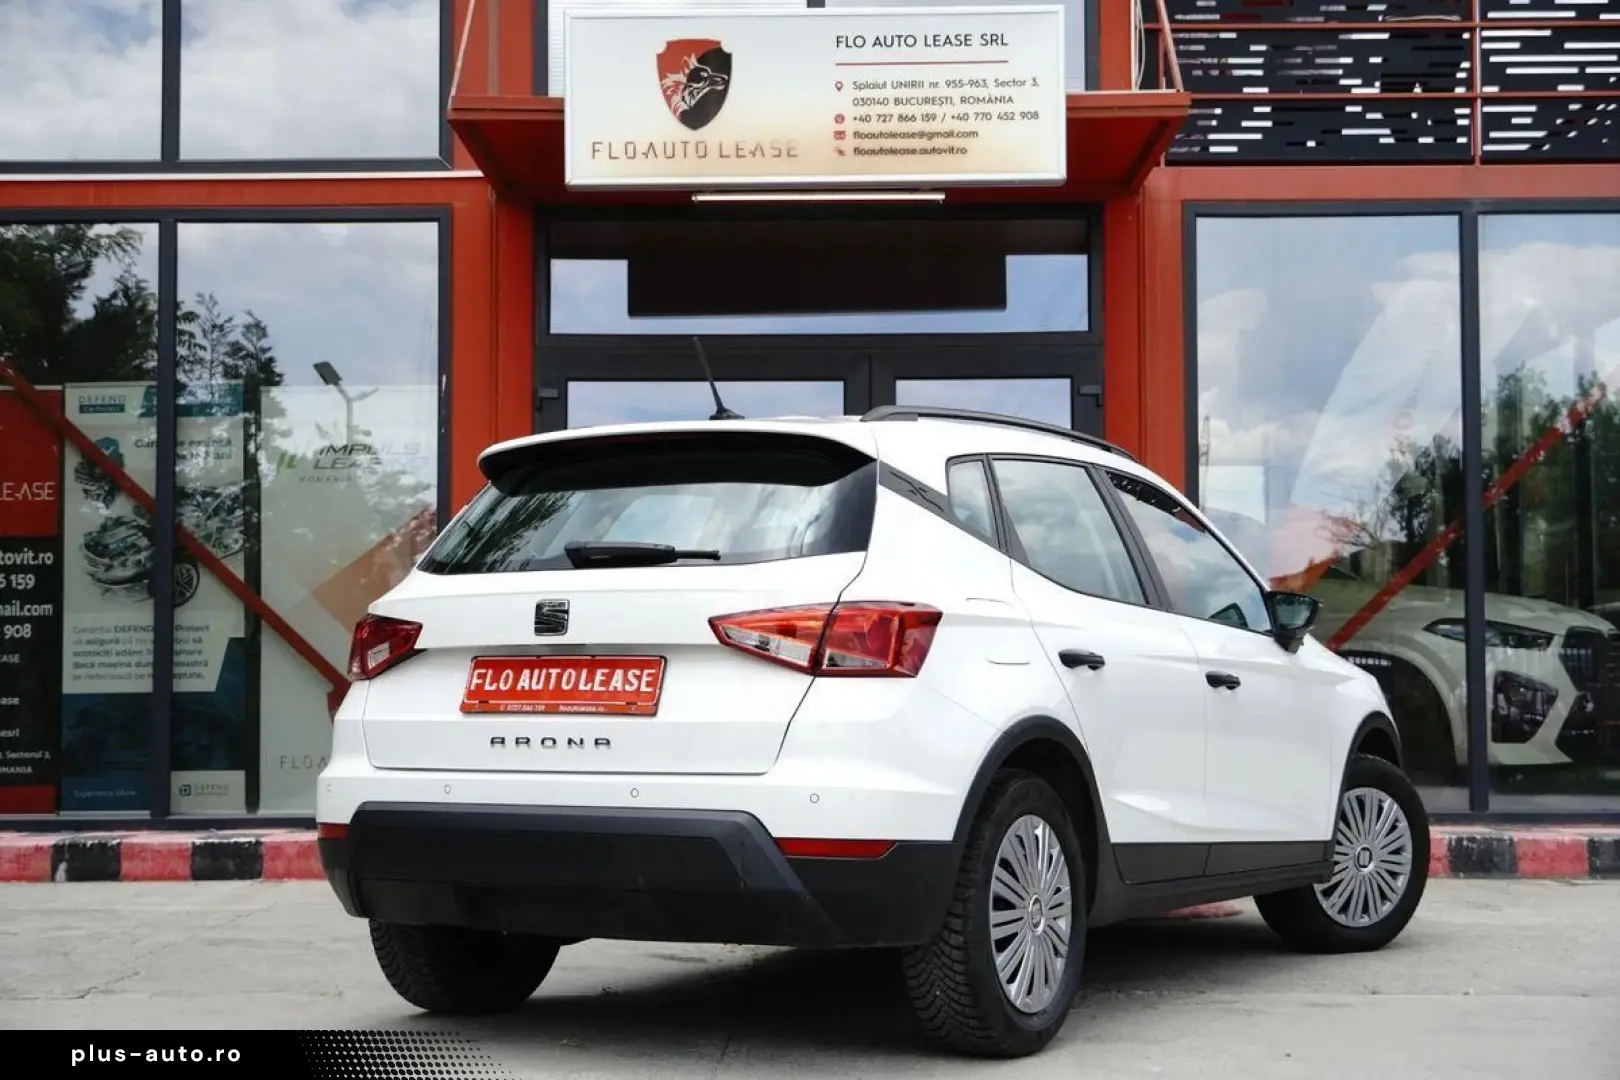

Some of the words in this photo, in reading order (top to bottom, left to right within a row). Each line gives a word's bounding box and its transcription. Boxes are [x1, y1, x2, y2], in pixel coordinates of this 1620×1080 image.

[835, 34, 866, 48] FLO
[872, 34, 917, 48] AUTO
[924, 33, 973, 47] LEASE
[980, 33, 1009, 46] SRL
[852, 80, 887, 92] Splaiul
[891, 80, 924, 89] UNIRII
[945, 79, 989, 90] 955-963,
[994, 78, 1027, 88] Sector
[852, 97, 889, 106] 030140
[853, 114, 872, 123] +40
[876, 114, 893, 123] 727
[897, 113, 917, 123] 866
[921, 113, 937, 122] 159
[951, 112, 970, 121] +40
[973, 112, 992, 121] 770
[997, 111, 1015, 121] 452
[1019, 110, 1039, 120] 908
[852, 129, 978, 141] floautolease@gmail.com
[853, 145, 968, 156] floautolease.autovit.ro
[10, 573, 36, 590] 159
[4, 623, 32, 639] 908
[469, 667, 514, 691] FLO
[516, 667, 576, 691] AUTO
[578, 667, 657, 693] LEASE
[489, 736, 612, 749] ARONA
